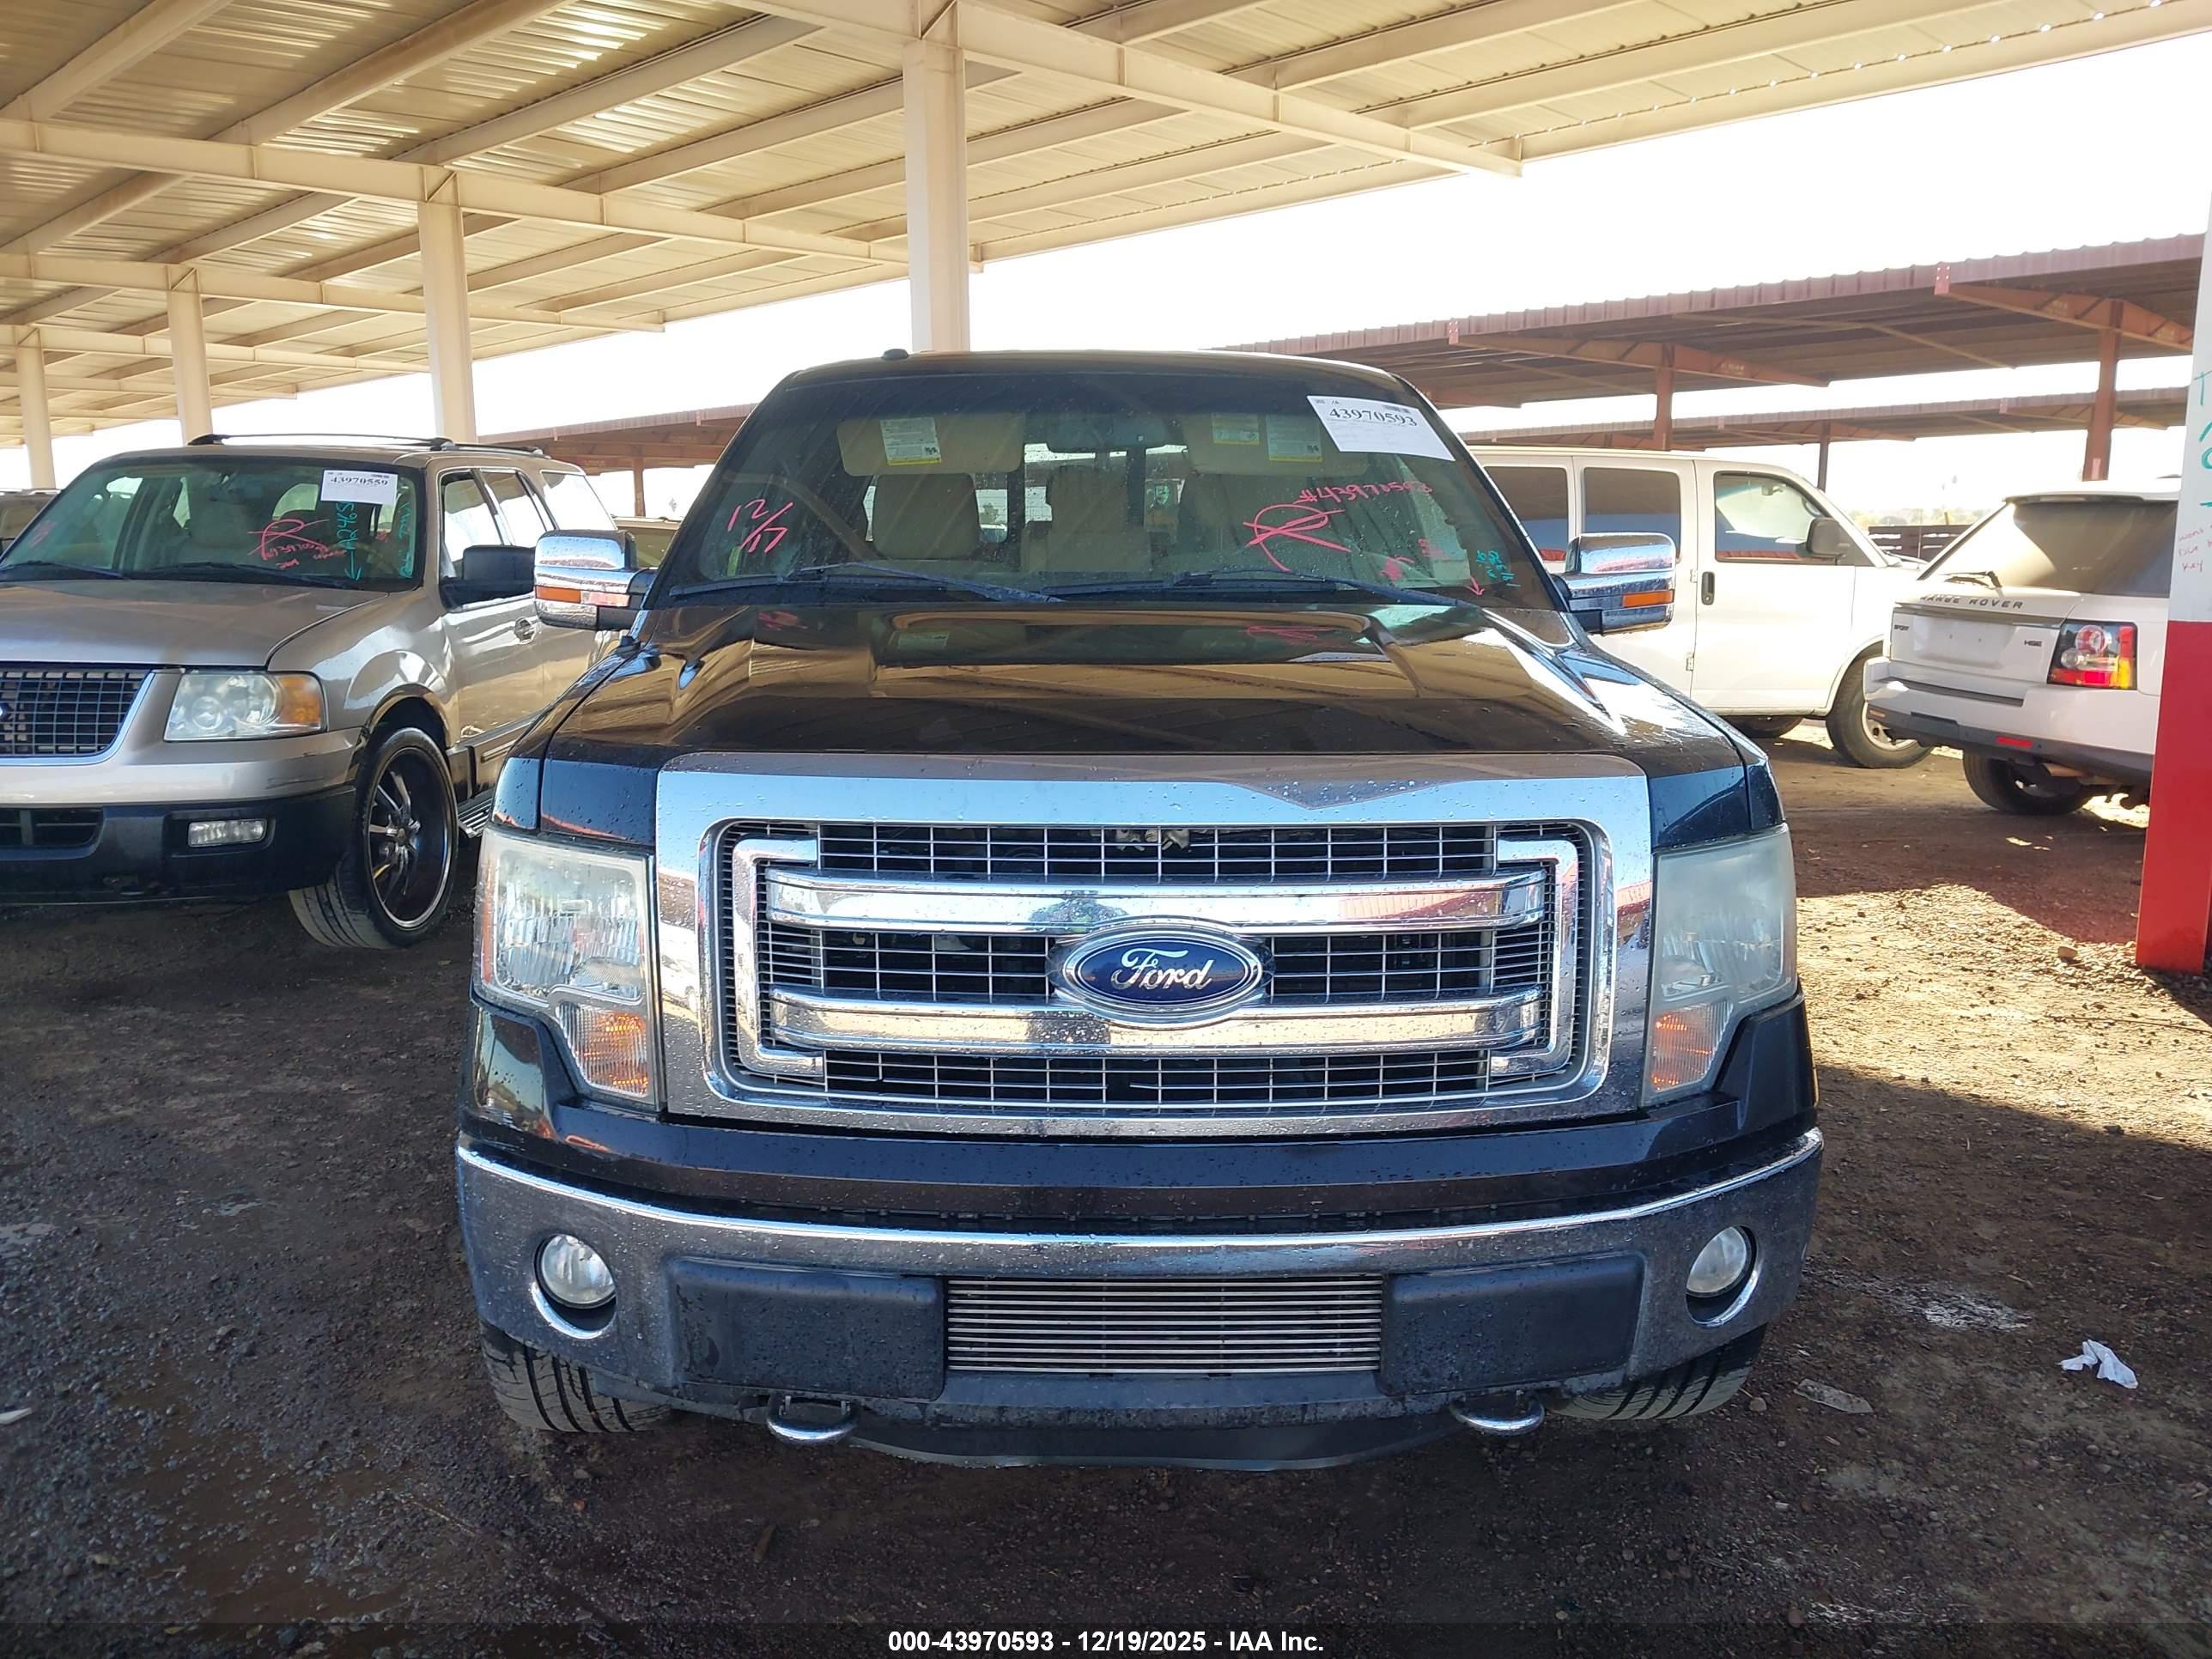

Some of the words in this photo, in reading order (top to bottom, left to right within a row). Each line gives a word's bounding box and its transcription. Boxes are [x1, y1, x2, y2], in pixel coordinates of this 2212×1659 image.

[1329, 408, 1417, 427] 43970593
[331, 476, 389, 486] 43970559
[727, 498, 793, 553] 12/17
[1969, 599, 2024, 610] ROVER
[1111, 947, 1215, 990] Ford
